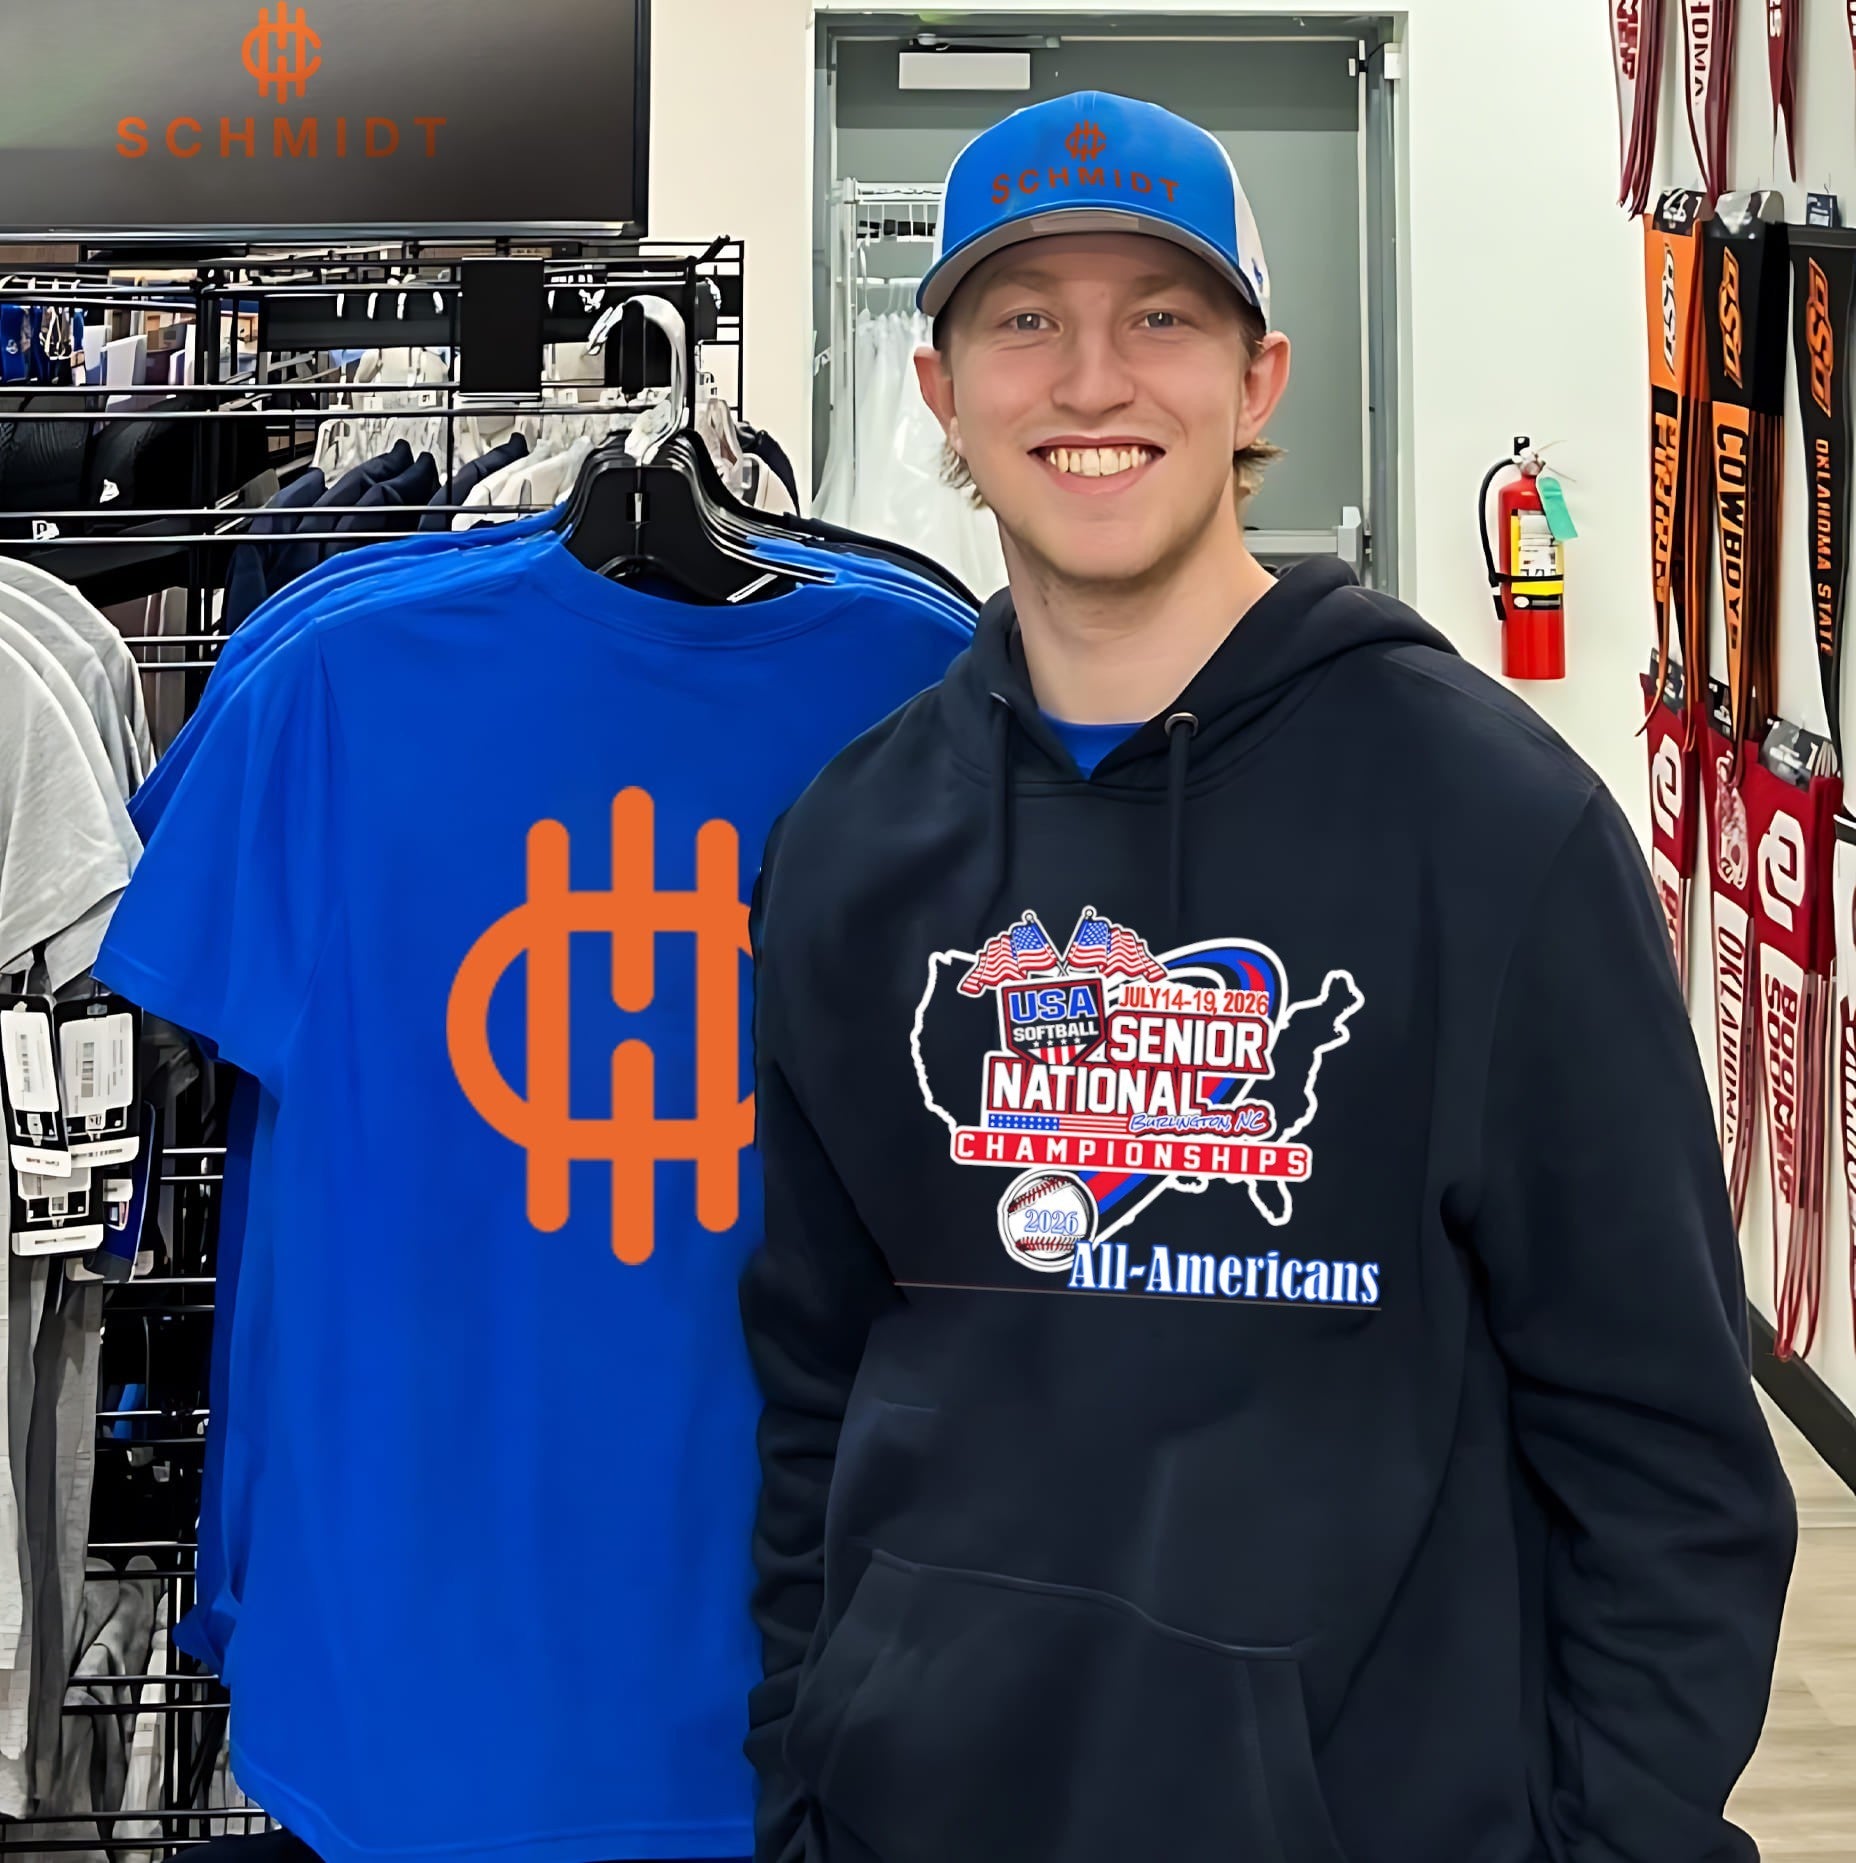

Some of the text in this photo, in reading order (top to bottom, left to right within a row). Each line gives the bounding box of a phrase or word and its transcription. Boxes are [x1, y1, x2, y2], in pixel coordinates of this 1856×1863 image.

[115, 116, 448, 159] SCHMIDT
[991, 167, 1180, 205] SCHMIDT
[1815, 438, 1832, 570] OKLAHOMA
[1009, 986, 1097, 1023] USA
[1223, 991, 1270, 1016] 2026
[1013, 1020, 1099, 1042] SOFTBALL
[1110, 1015, 1264, 1069] SENIOR
[992, 1061, 1202, 1116] NATIONAL
[1236, 1110, 1265, 1131] NC
[957, 1133, 1308, 1176] CHAMPIONSHIPS
[1024, 1208, 1080, 1236] 2026
[1067, 1239, 1380, 1304] All-Americans
